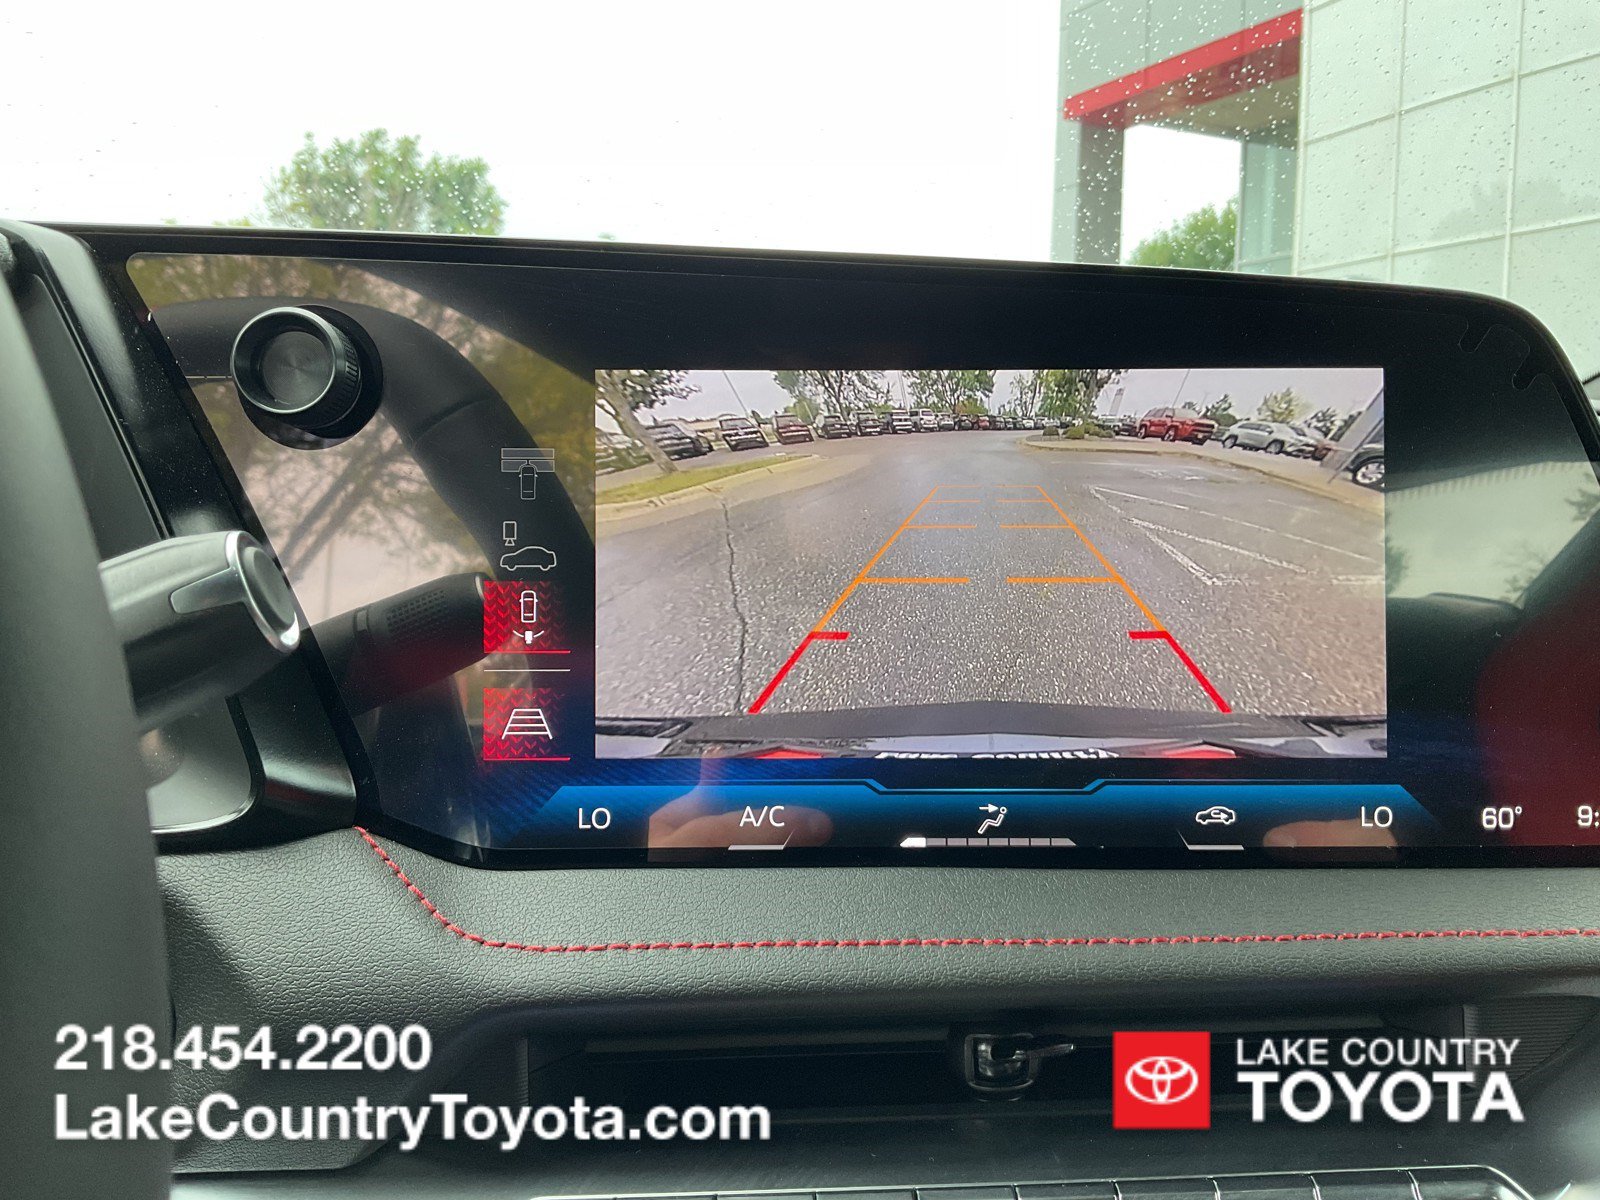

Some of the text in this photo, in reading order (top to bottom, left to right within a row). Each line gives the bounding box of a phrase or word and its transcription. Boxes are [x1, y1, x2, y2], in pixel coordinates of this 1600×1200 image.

[579, 807, 611, 829] LO
[739, 805, 785, 828] A/C
[1360, 806, 1394, 828] LO
[1481, 805, 1523, 830] 60°
